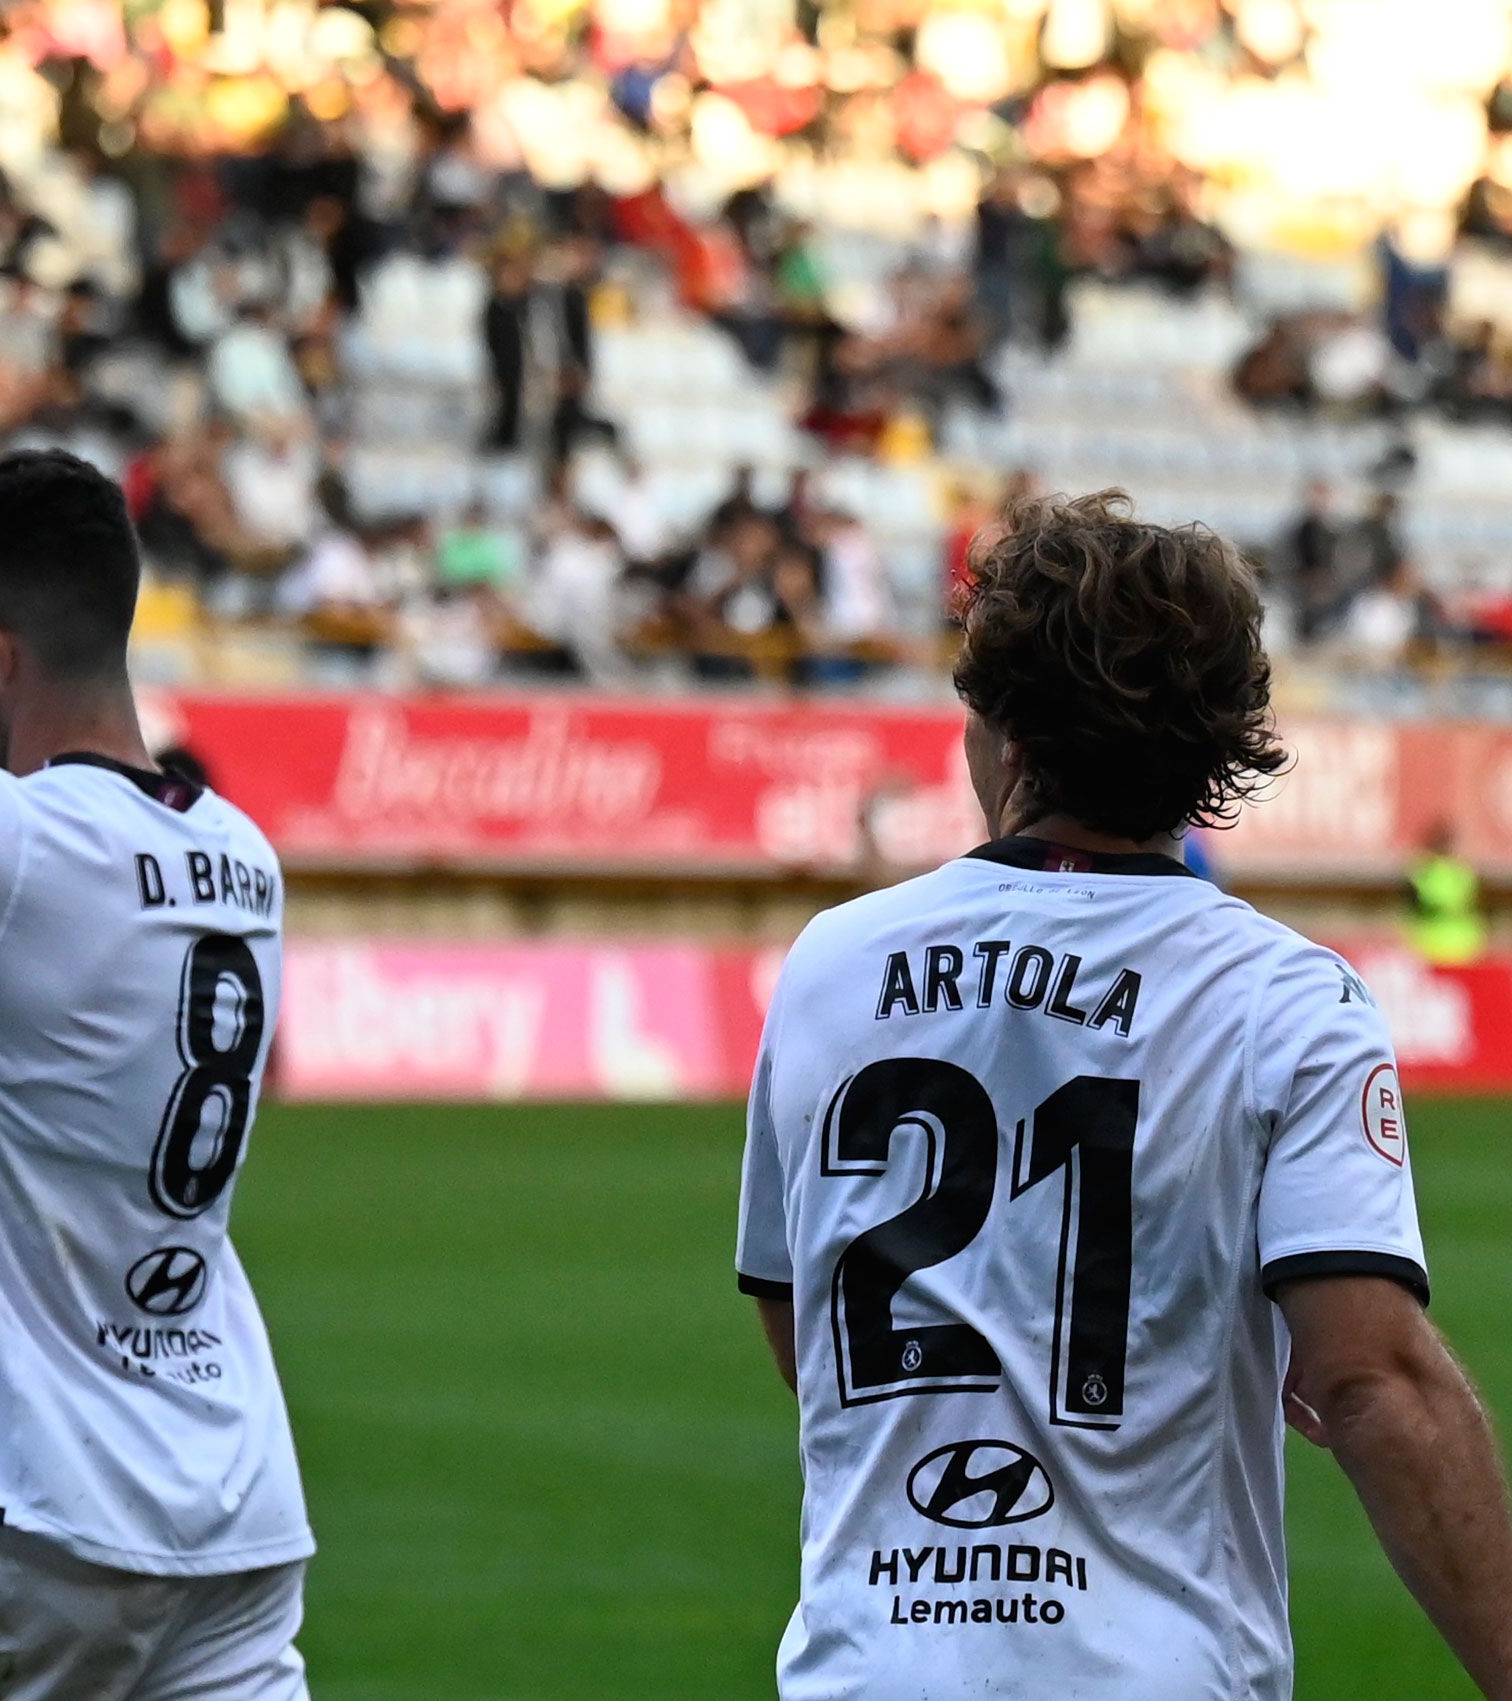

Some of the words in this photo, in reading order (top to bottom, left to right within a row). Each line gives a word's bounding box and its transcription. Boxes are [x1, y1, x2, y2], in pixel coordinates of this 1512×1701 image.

[135, 853, 176, 910] D.
[876, 940, 1143, 1037] ARTOLA
[148, 935, 265, 1220] 8
[819, 1056, 1140, 1432] 21
[868, 1544, 1088, 1591] HYUNDAI
[890, 1593, 1065, 1626] Lemauto
